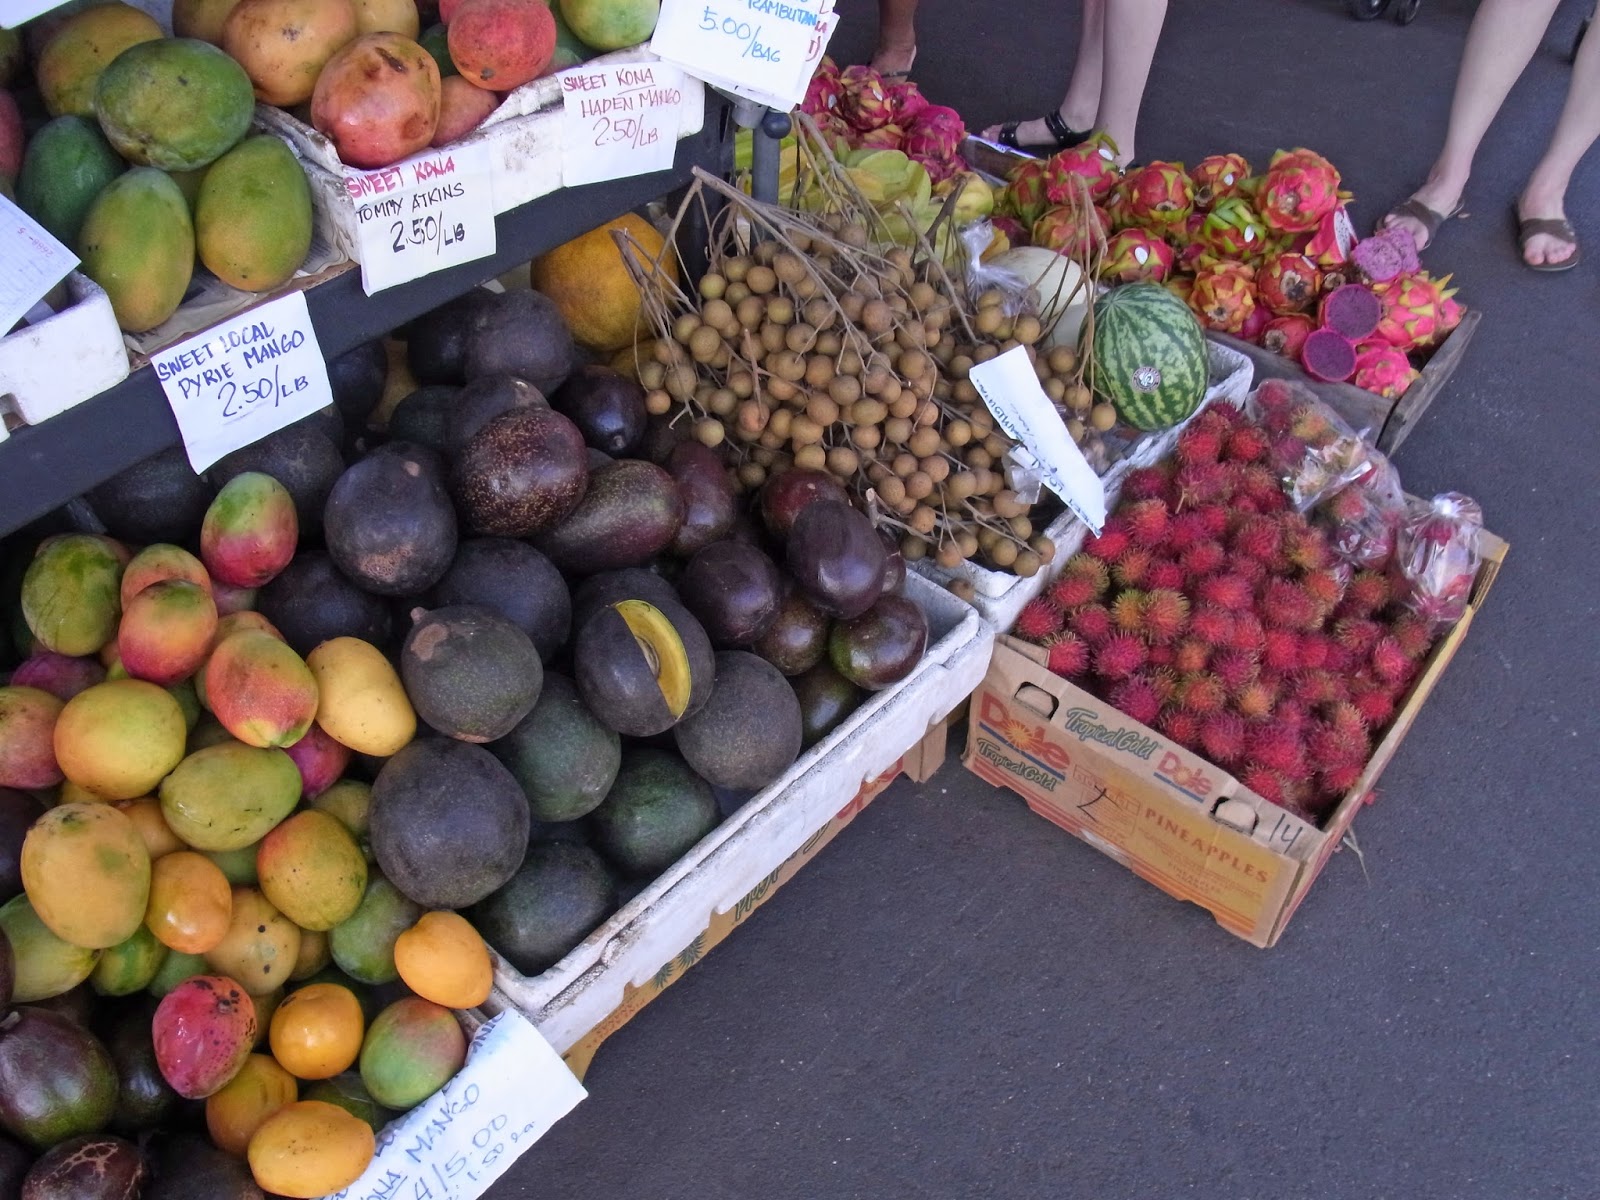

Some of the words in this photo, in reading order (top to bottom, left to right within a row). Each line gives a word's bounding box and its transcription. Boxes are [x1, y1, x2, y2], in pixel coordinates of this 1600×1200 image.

[563, 73, 607, 92] SWEET
[615, 68, 655, 87] KONA
[581, 97, 634, 118] HADEN
[638, 88, 682, 108] MANGO
[592, 114, 659, 150] 2.50/LB
[344, 167, 404, 199] SWEET
[412, 156, 456, 184] KONA
[356, 197, 404, 224] TOMMY
[411, 182, 465, 212] ATKINS
[157, 342, 214, 382] SWEET
[218, 321, 275, 354] LOCAL
[178, 361, 235, 399] PYRIE
[243, 329, 305, 369] MANGO
[217, 364, 309, 417] 2.50/LB
[980, 690, 1071, 770] Dole
[1065, 707, 1121, 747] Tropical
[1116, 731, 1159, 760] Gold
[977, 737, 1025, 776] Tropical
[1023, 765, 1057, 792] Gold
[1156, 750, 1213, 796] Dole
[1145, 807, 1269, 882] PINEAPPLES
[1269, 813, 1303, 855] 14
[405, 1083, 480, 1163] MANGO
